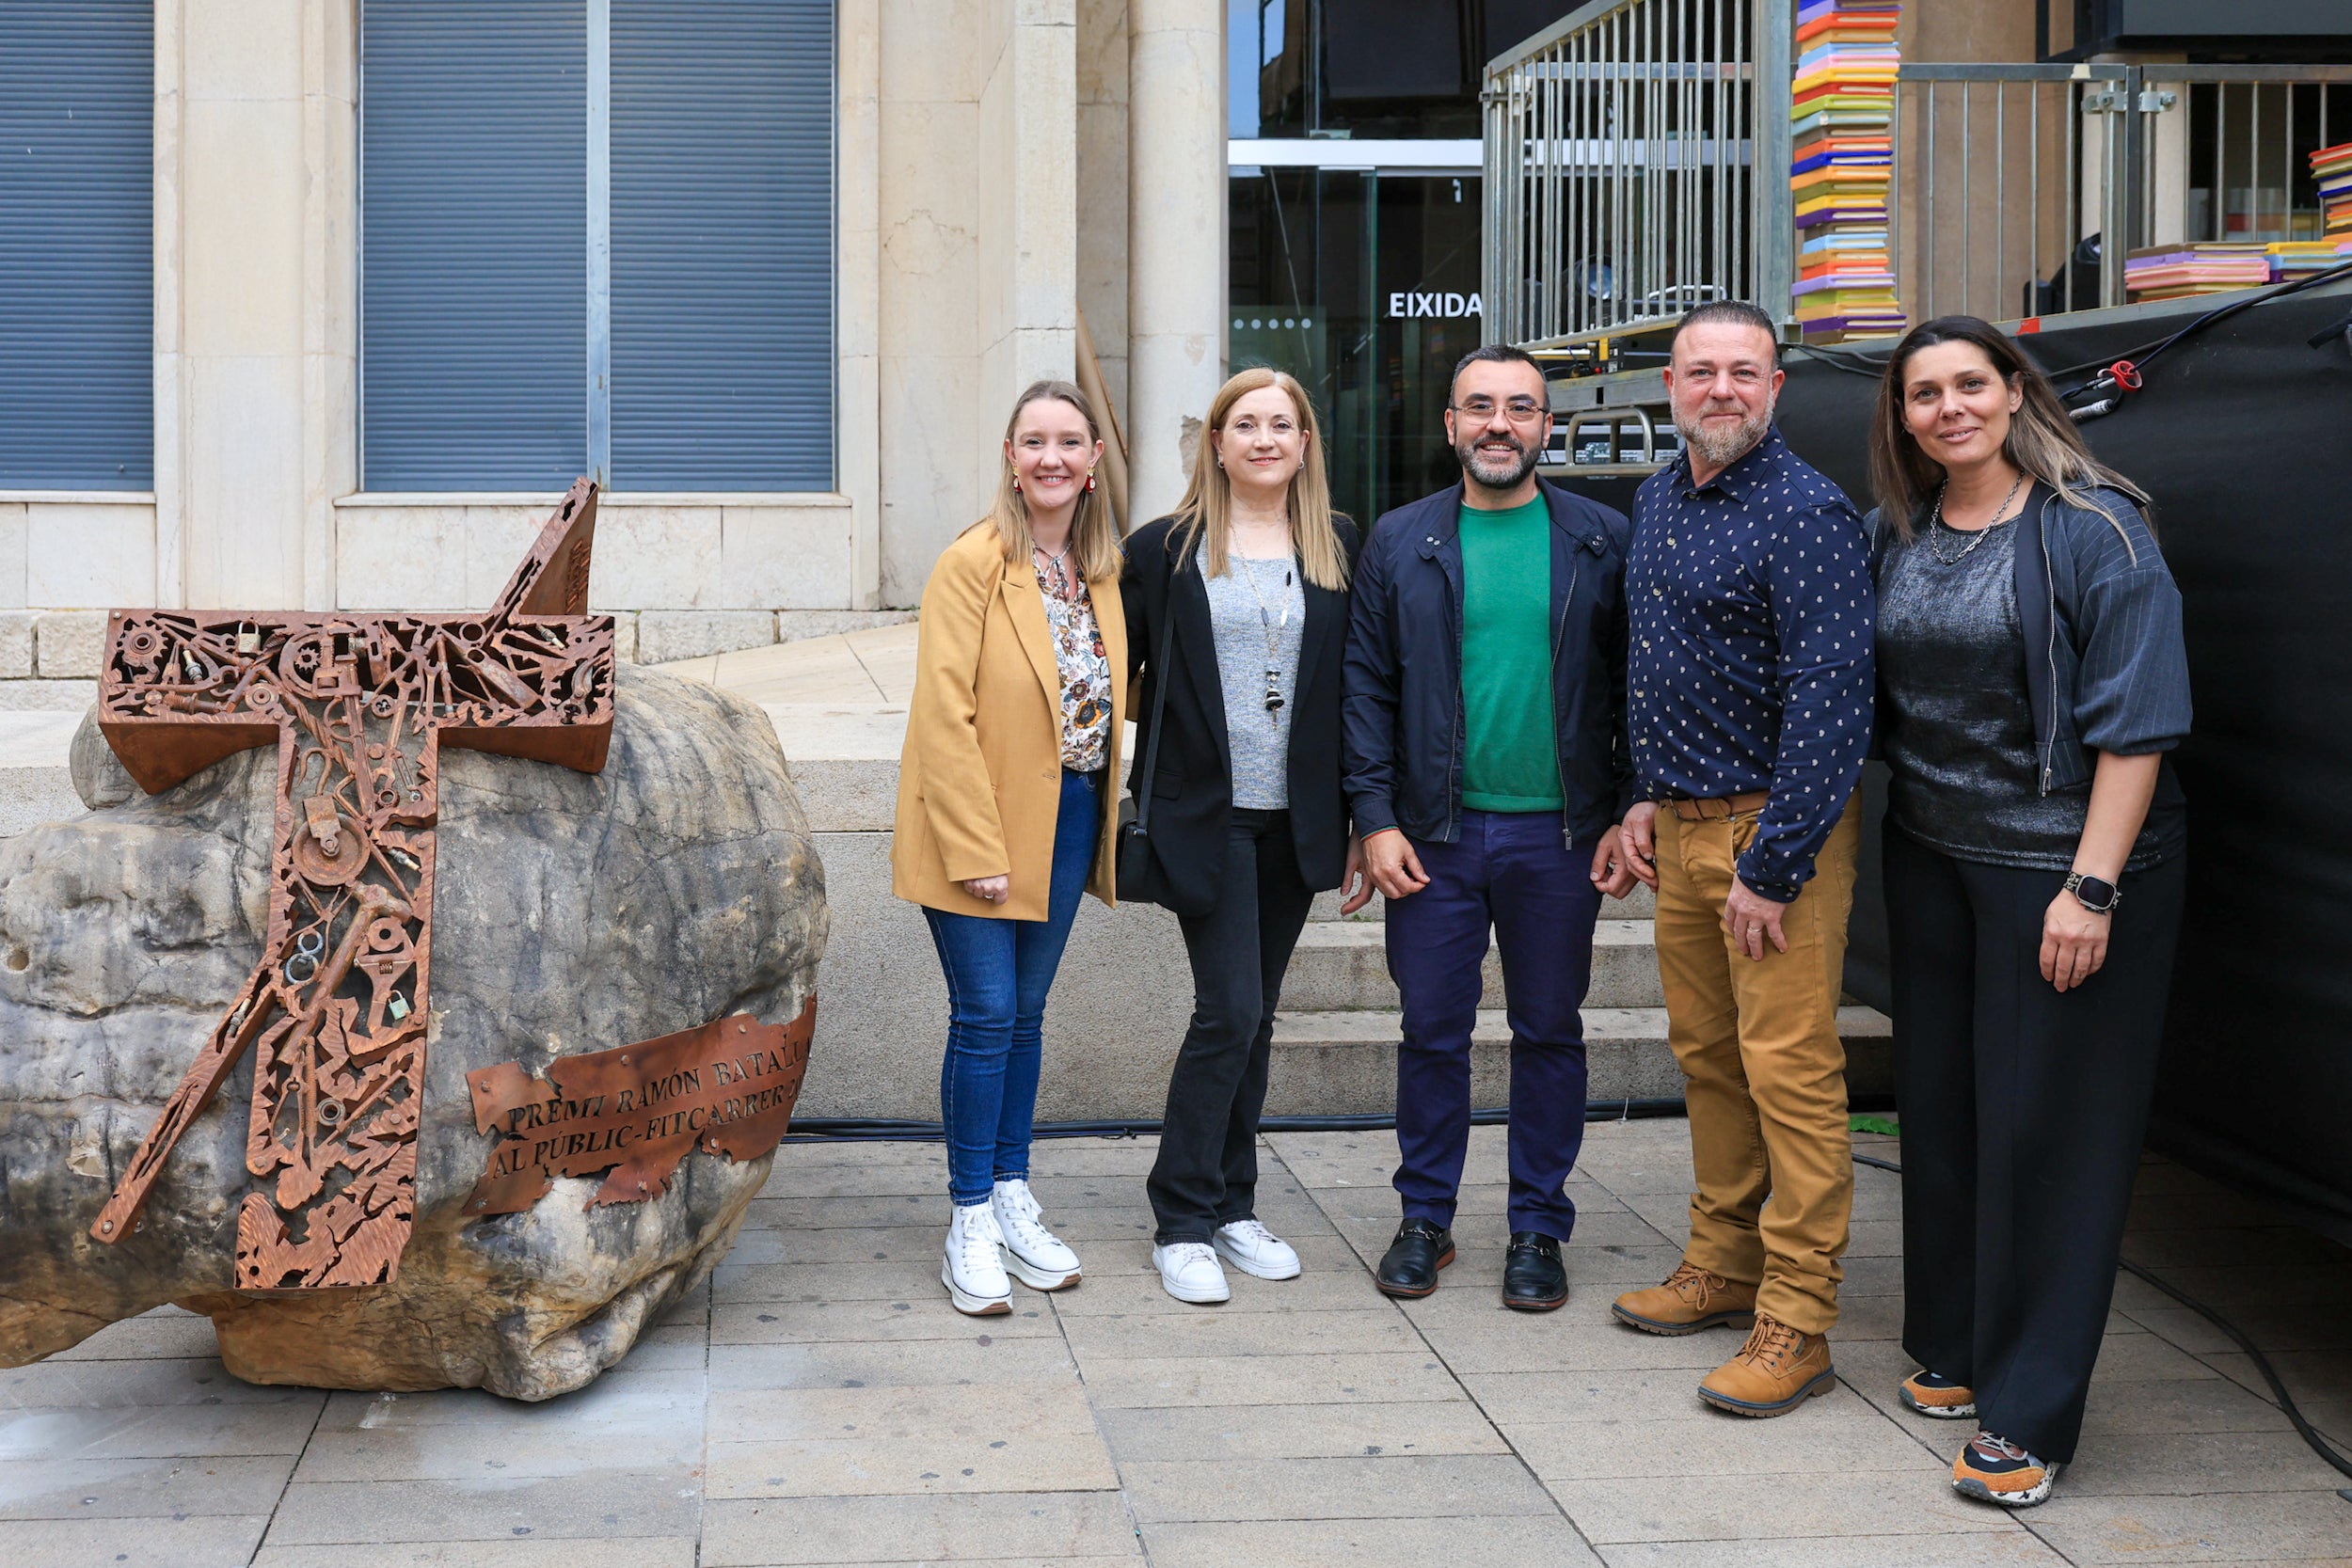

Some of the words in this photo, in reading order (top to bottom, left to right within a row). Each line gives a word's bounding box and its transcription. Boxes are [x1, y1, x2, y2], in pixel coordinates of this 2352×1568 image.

[1390, 293, 1482, 318] EIXIDA
[508, 1095, 606, 1132] PREMI
[615, 1067, 701, 1114] RAMÓN
[493, 1148, 527, 1179] AL
